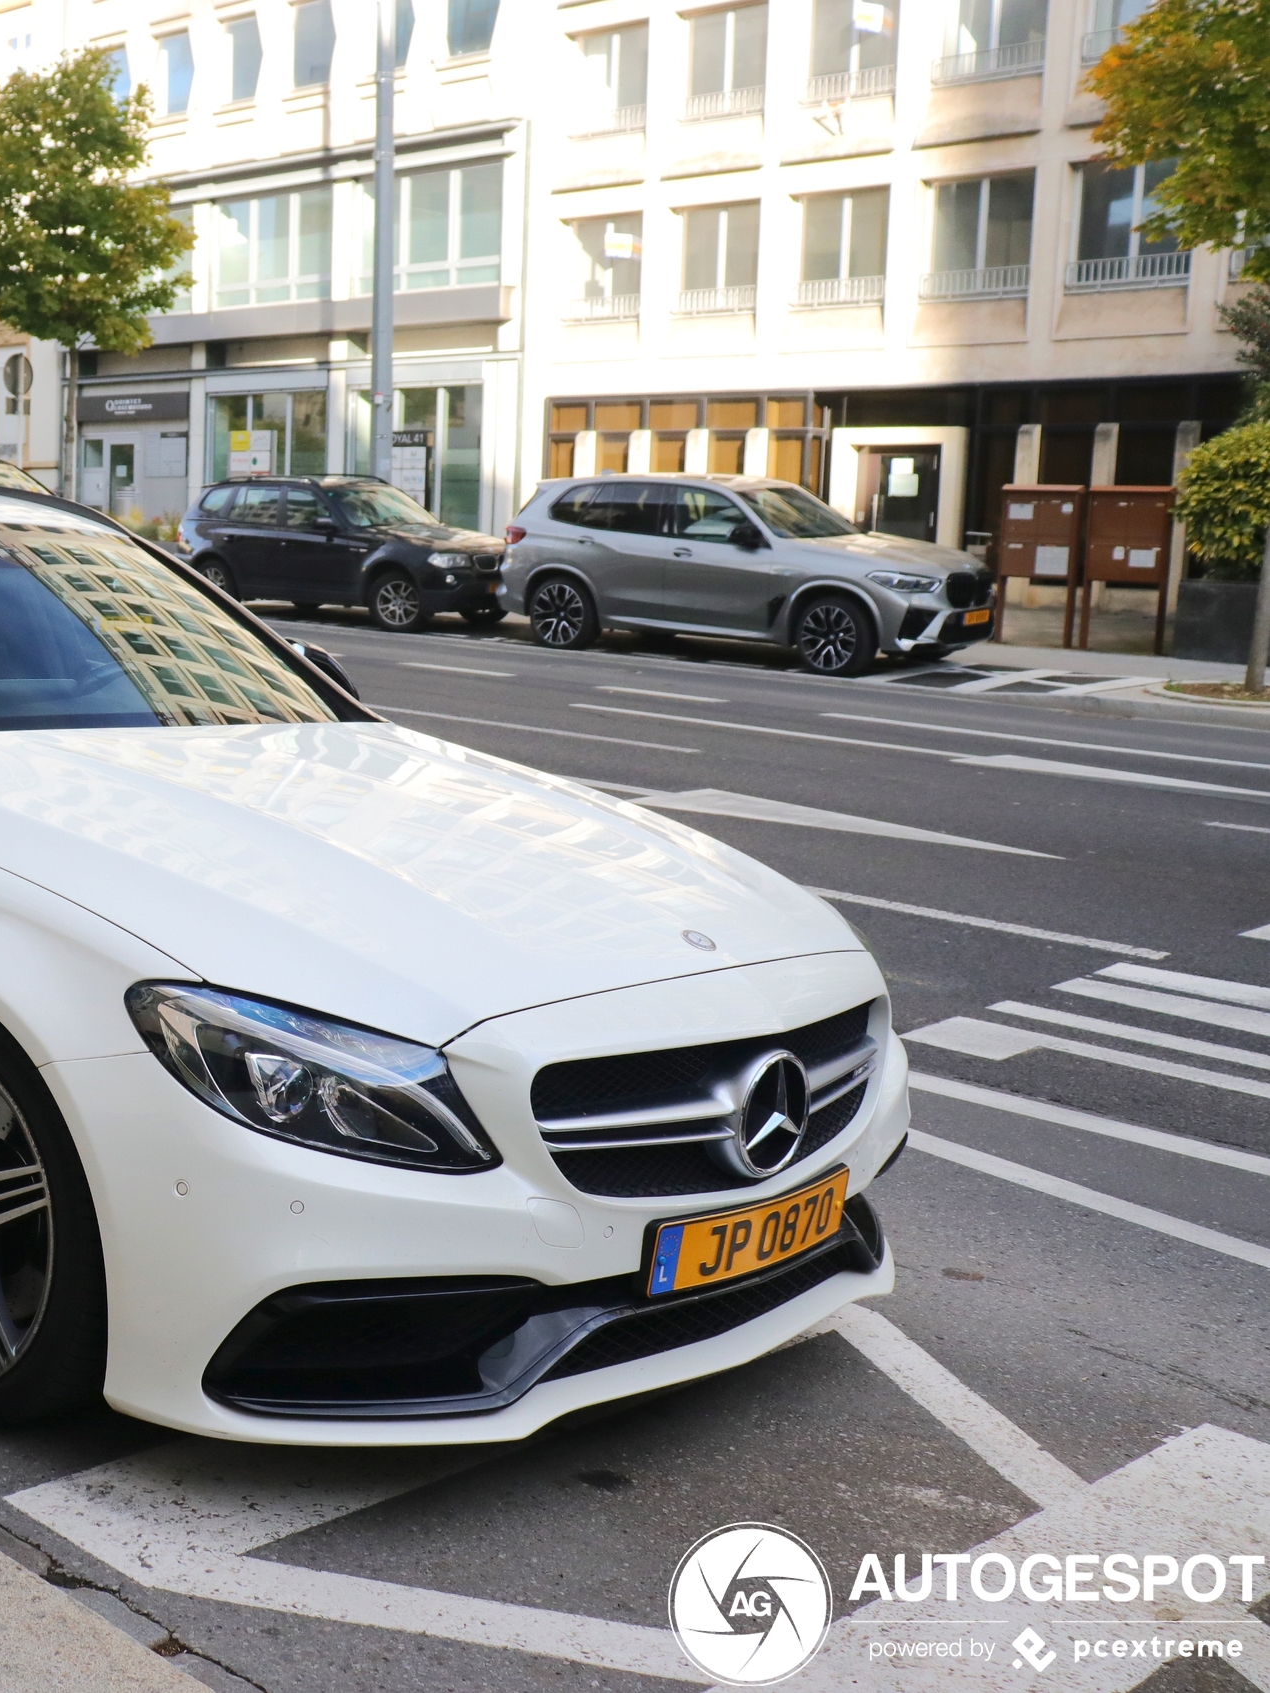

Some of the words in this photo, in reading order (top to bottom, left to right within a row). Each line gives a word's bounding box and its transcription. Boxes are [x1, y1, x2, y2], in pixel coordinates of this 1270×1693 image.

[392, 433, 412, 444] OYAL
[413, 433, 425, 443] 41
[699, 1219, 753, 1277] JP
[757, 1186, 835, 1262] 0870
[658, 1265, 668, 1283] L
